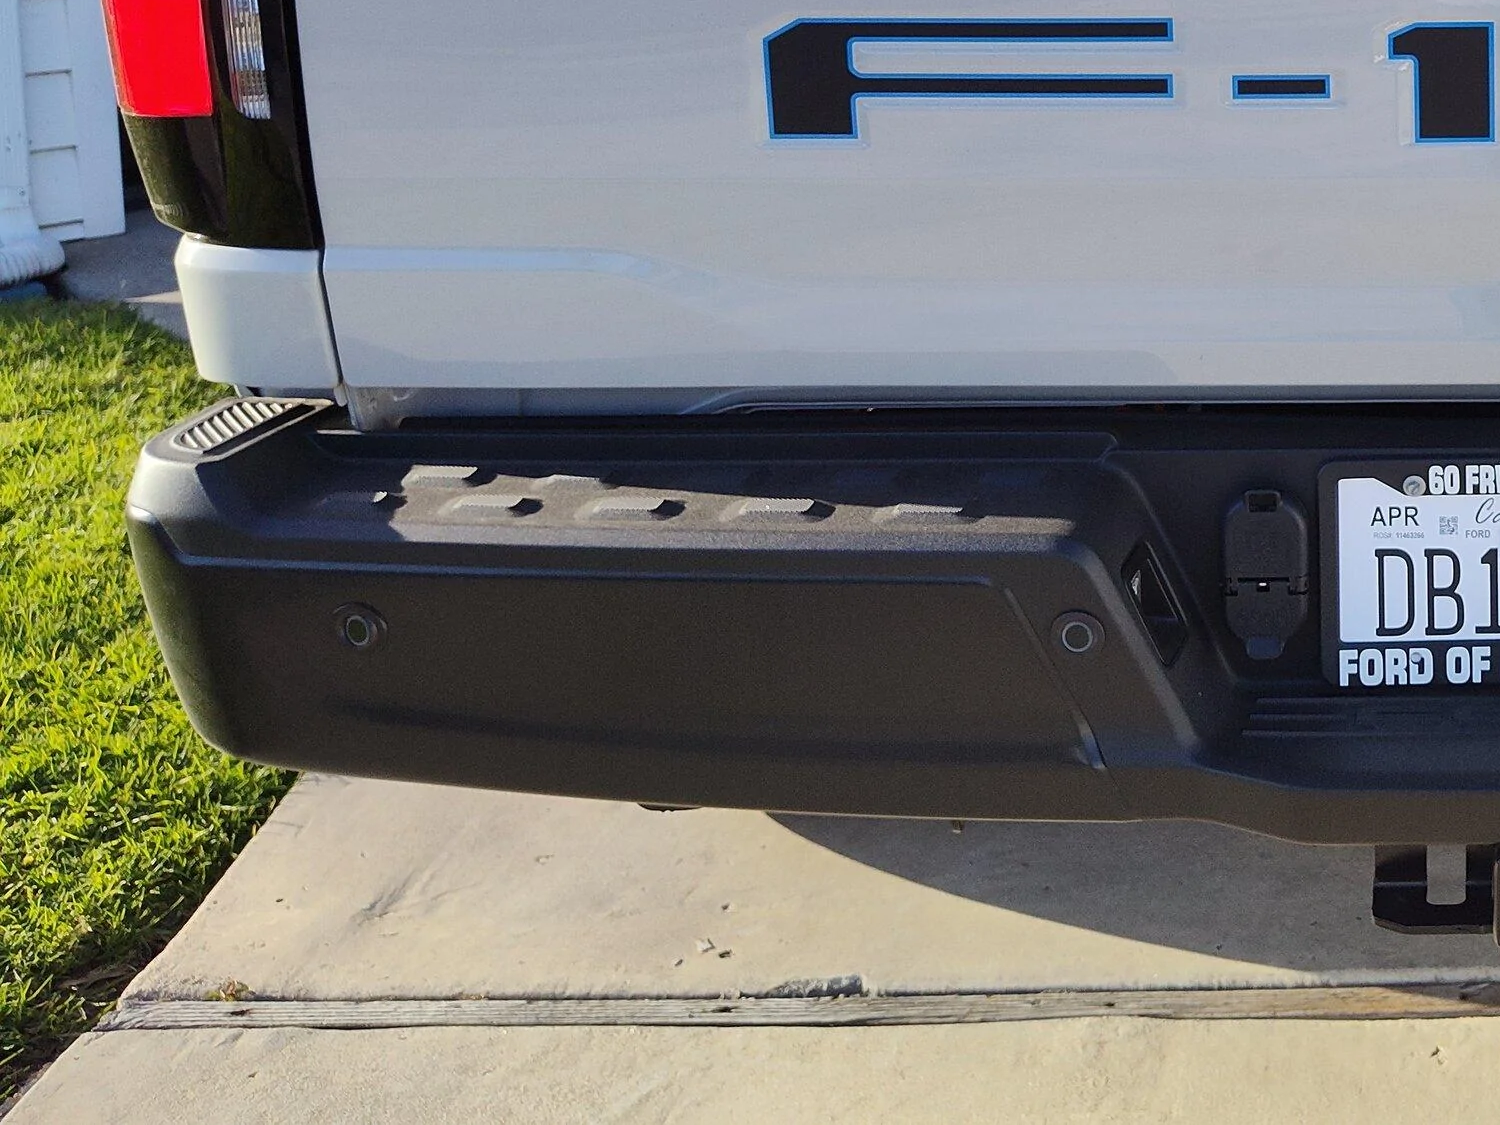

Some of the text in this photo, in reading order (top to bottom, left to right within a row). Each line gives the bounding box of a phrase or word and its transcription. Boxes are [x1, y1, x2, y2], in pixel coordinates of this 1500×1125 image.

[1428, 466, 1459, 494] 60
[1370, 506, 1419, 527] APR
[1465, 530, 1491, 538] FORD
[1338, 647, 1434, 687] FORD
[1446, 646, 1491, 685] OF
